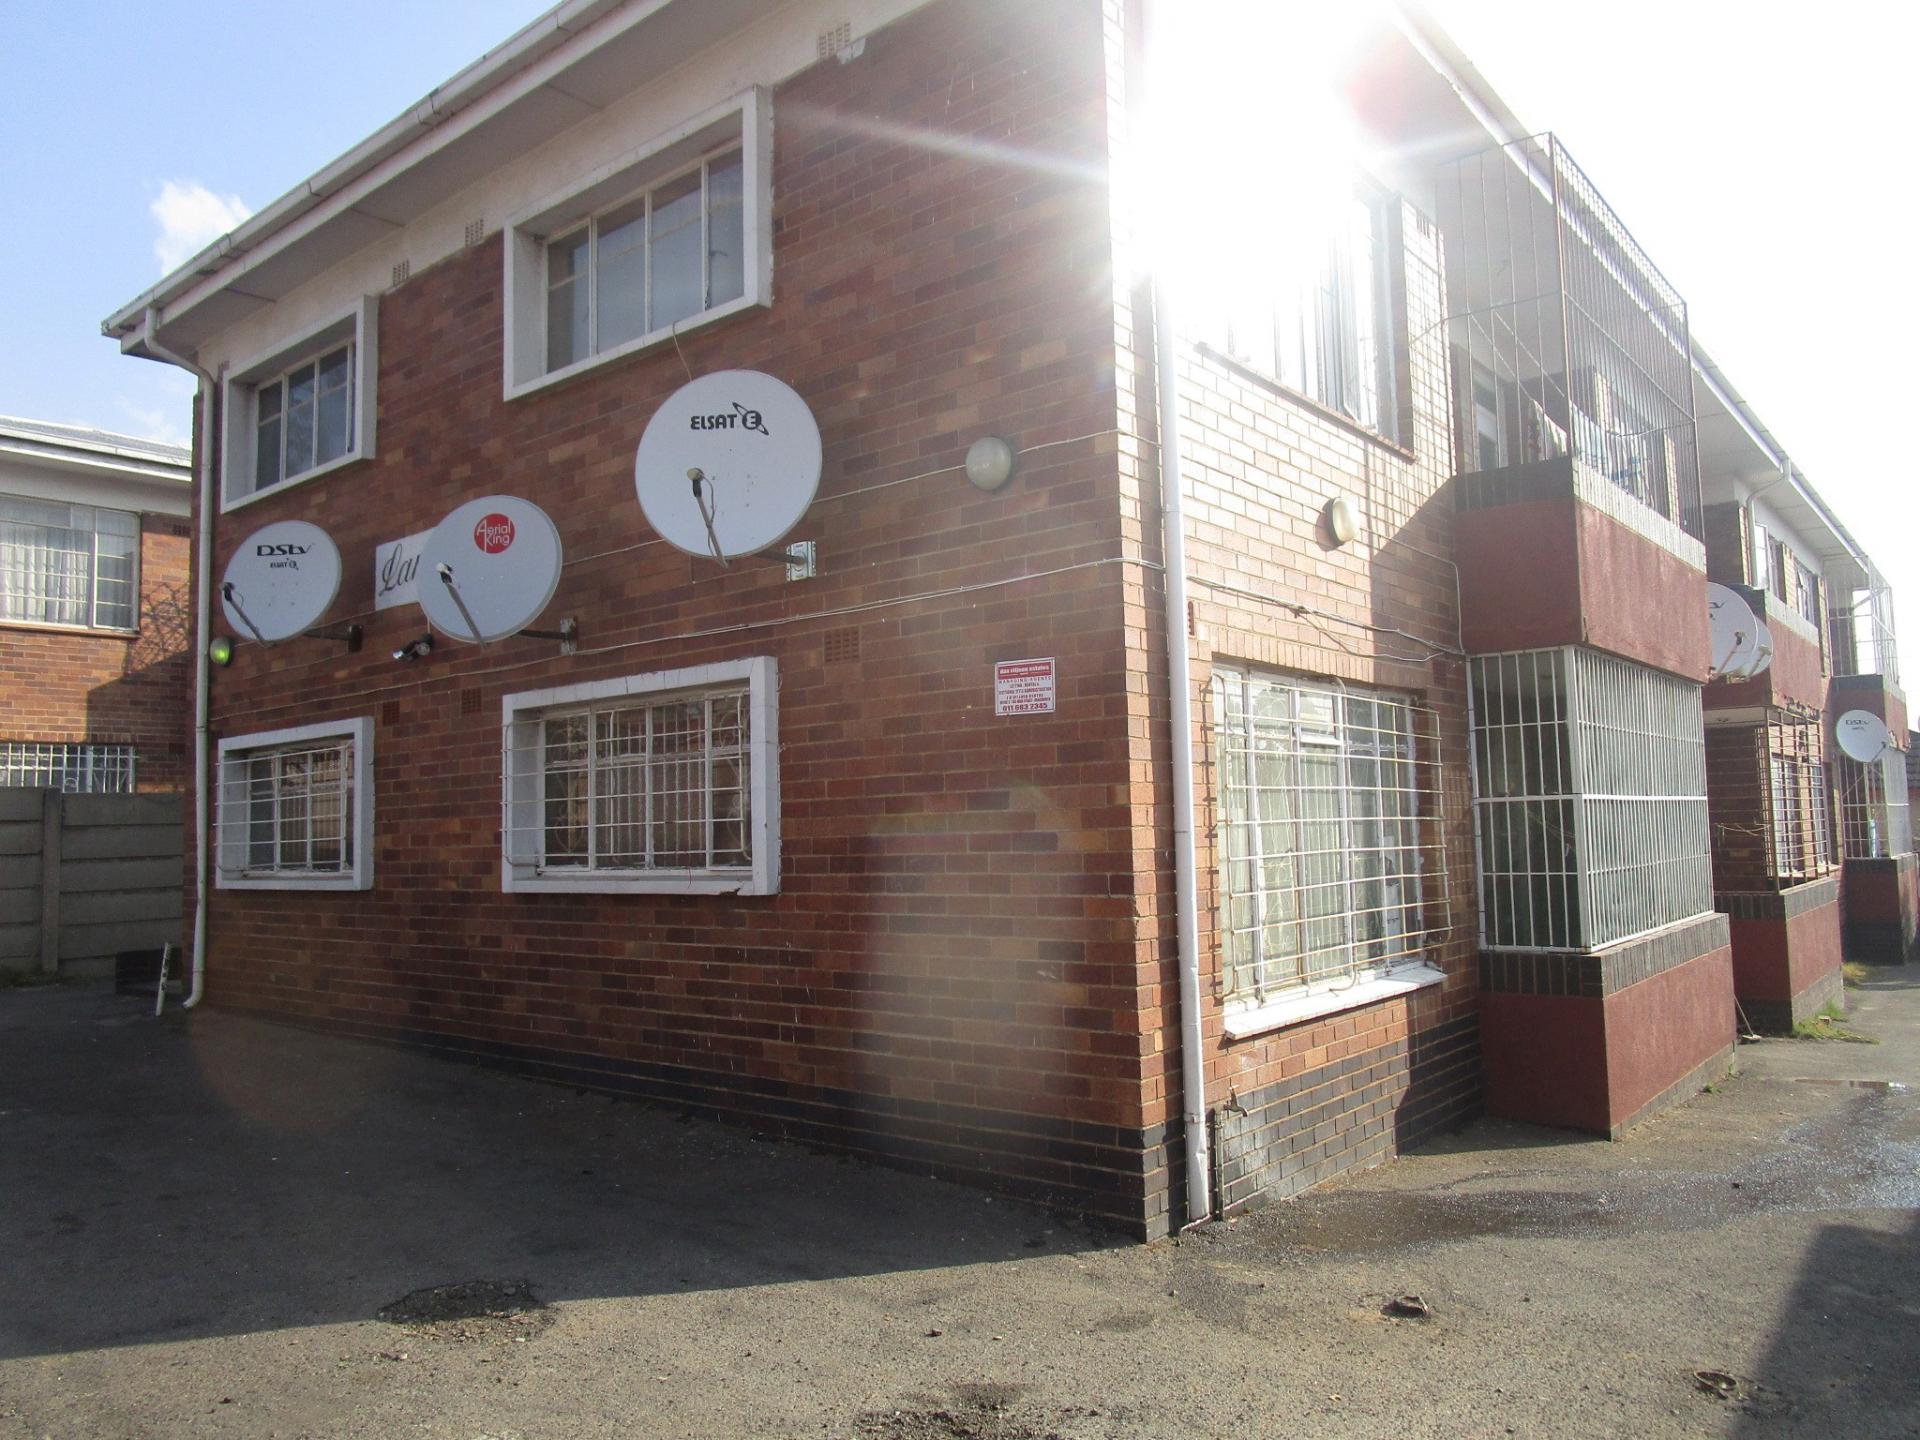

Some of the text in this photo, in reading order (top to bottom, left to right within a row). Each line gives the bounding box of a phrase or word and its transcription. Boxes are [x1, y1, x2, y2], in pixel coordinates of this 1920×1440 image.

[691, 414, 737, 430] ELSAT
[476, 519, 511, 540] Aerial
[484, 534, 510, 547] King
[257, 544, 309, 556] DStv
